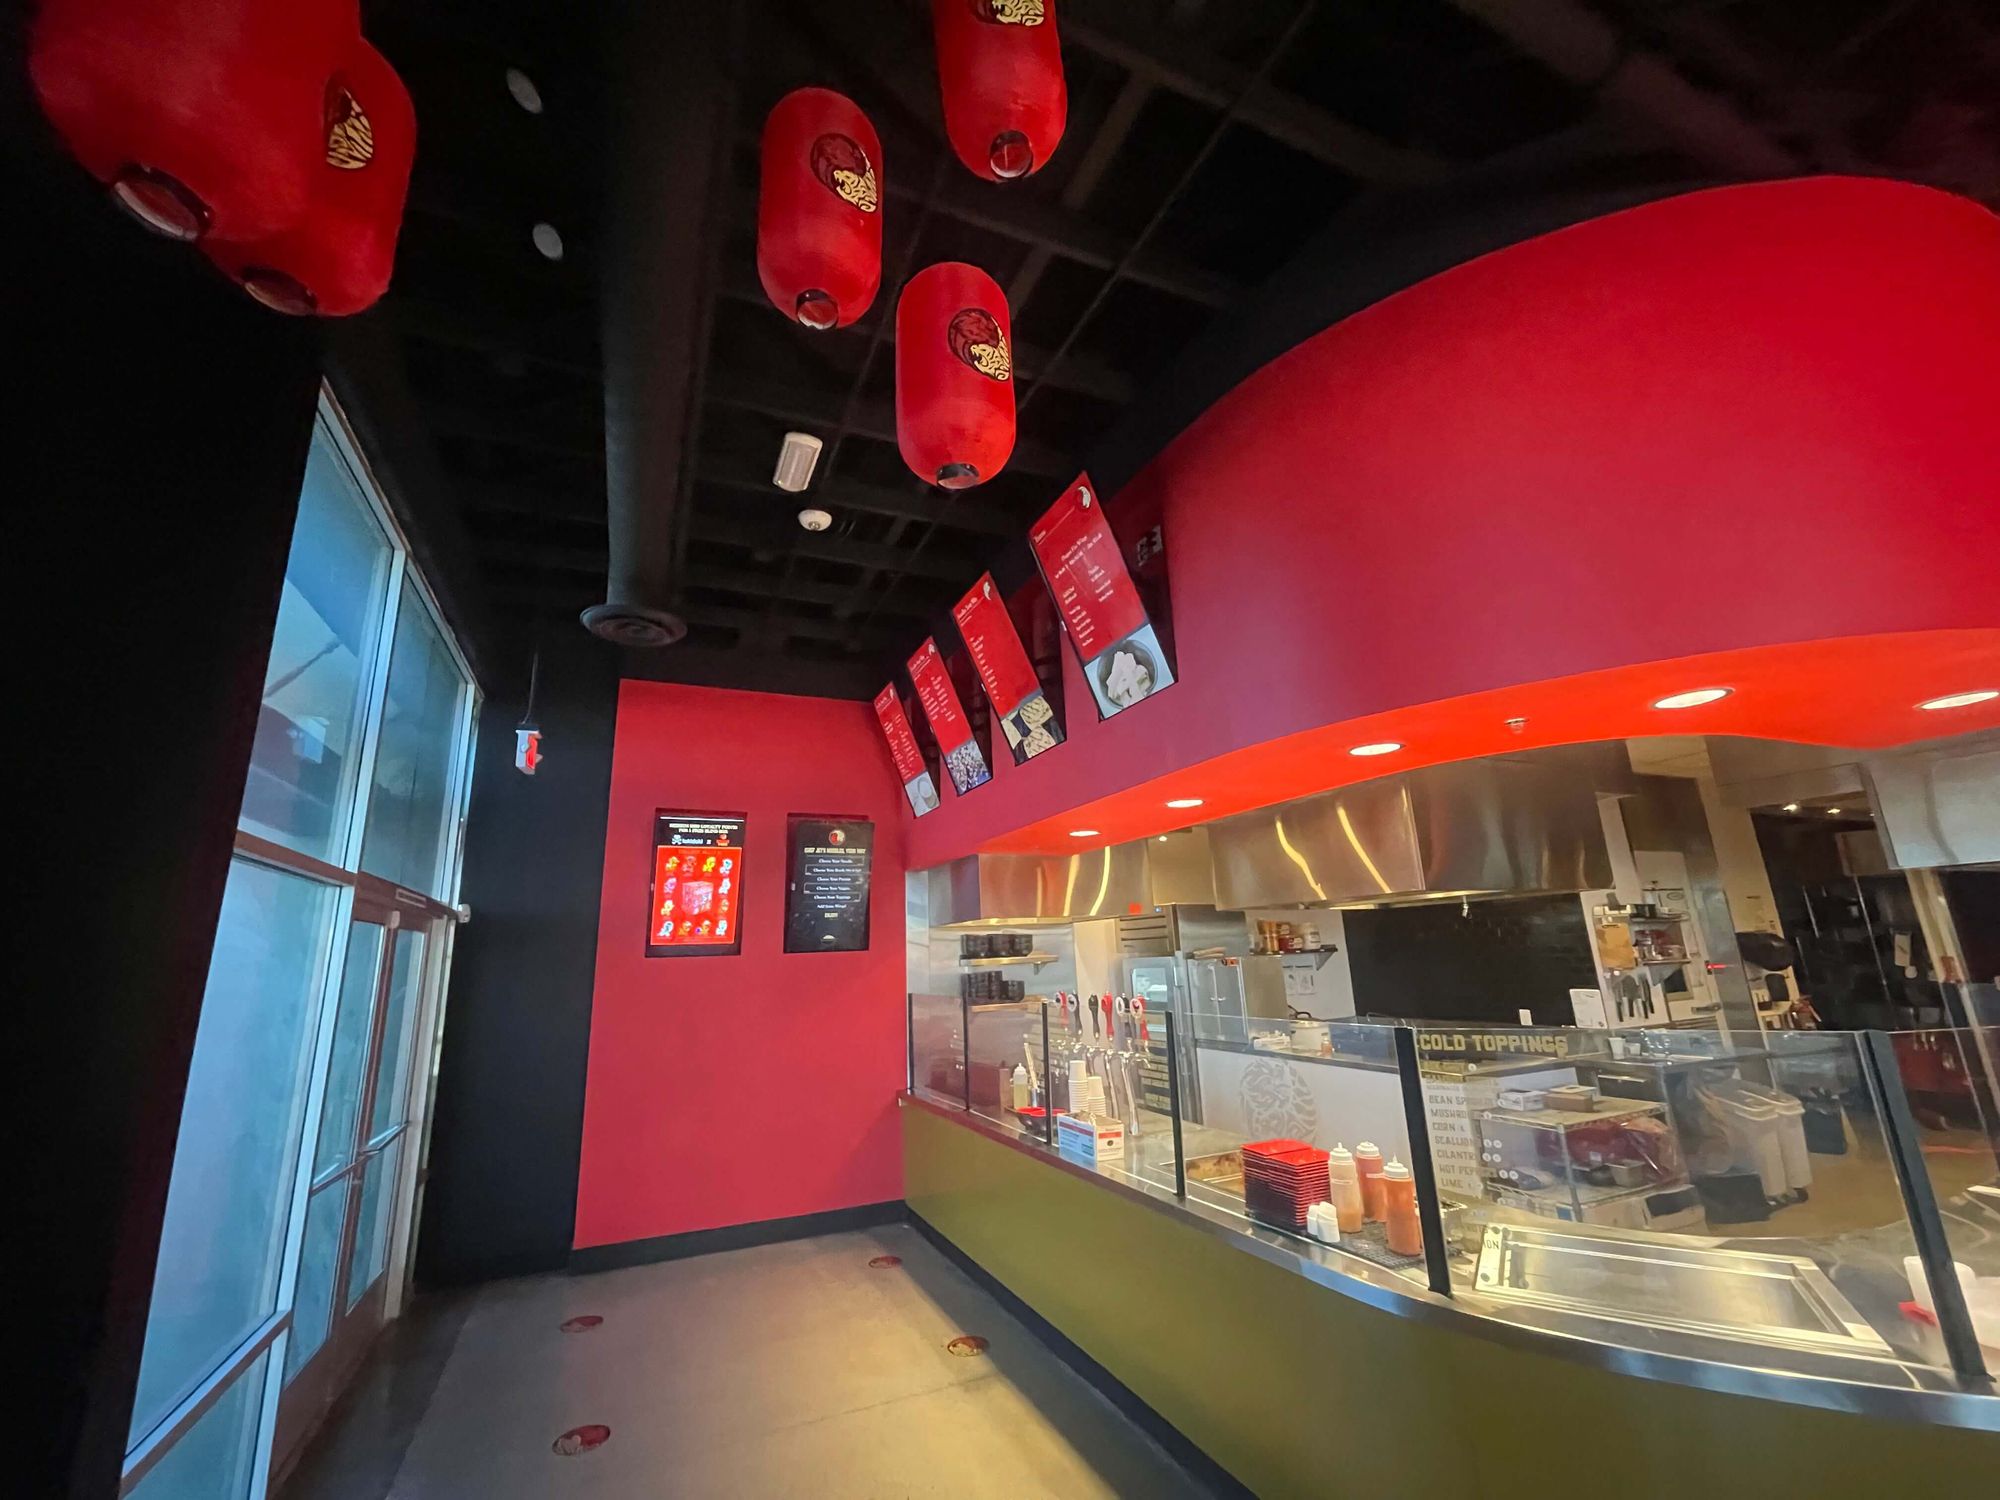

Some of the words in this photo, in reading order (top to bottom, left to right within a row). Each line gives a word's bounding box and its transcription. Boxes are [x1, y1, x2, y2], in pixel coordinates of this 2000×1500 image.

[1419, 1034, 1466, 1051] COLD
[1471, 1034, 1568, 1054] TOPPINGS
[1428, 1094, 1453, 1105] BEAN
[1430, 1108, 1473, 1120] MUSHRO
[1436, 1149, 1477, 1161] CILANTR
